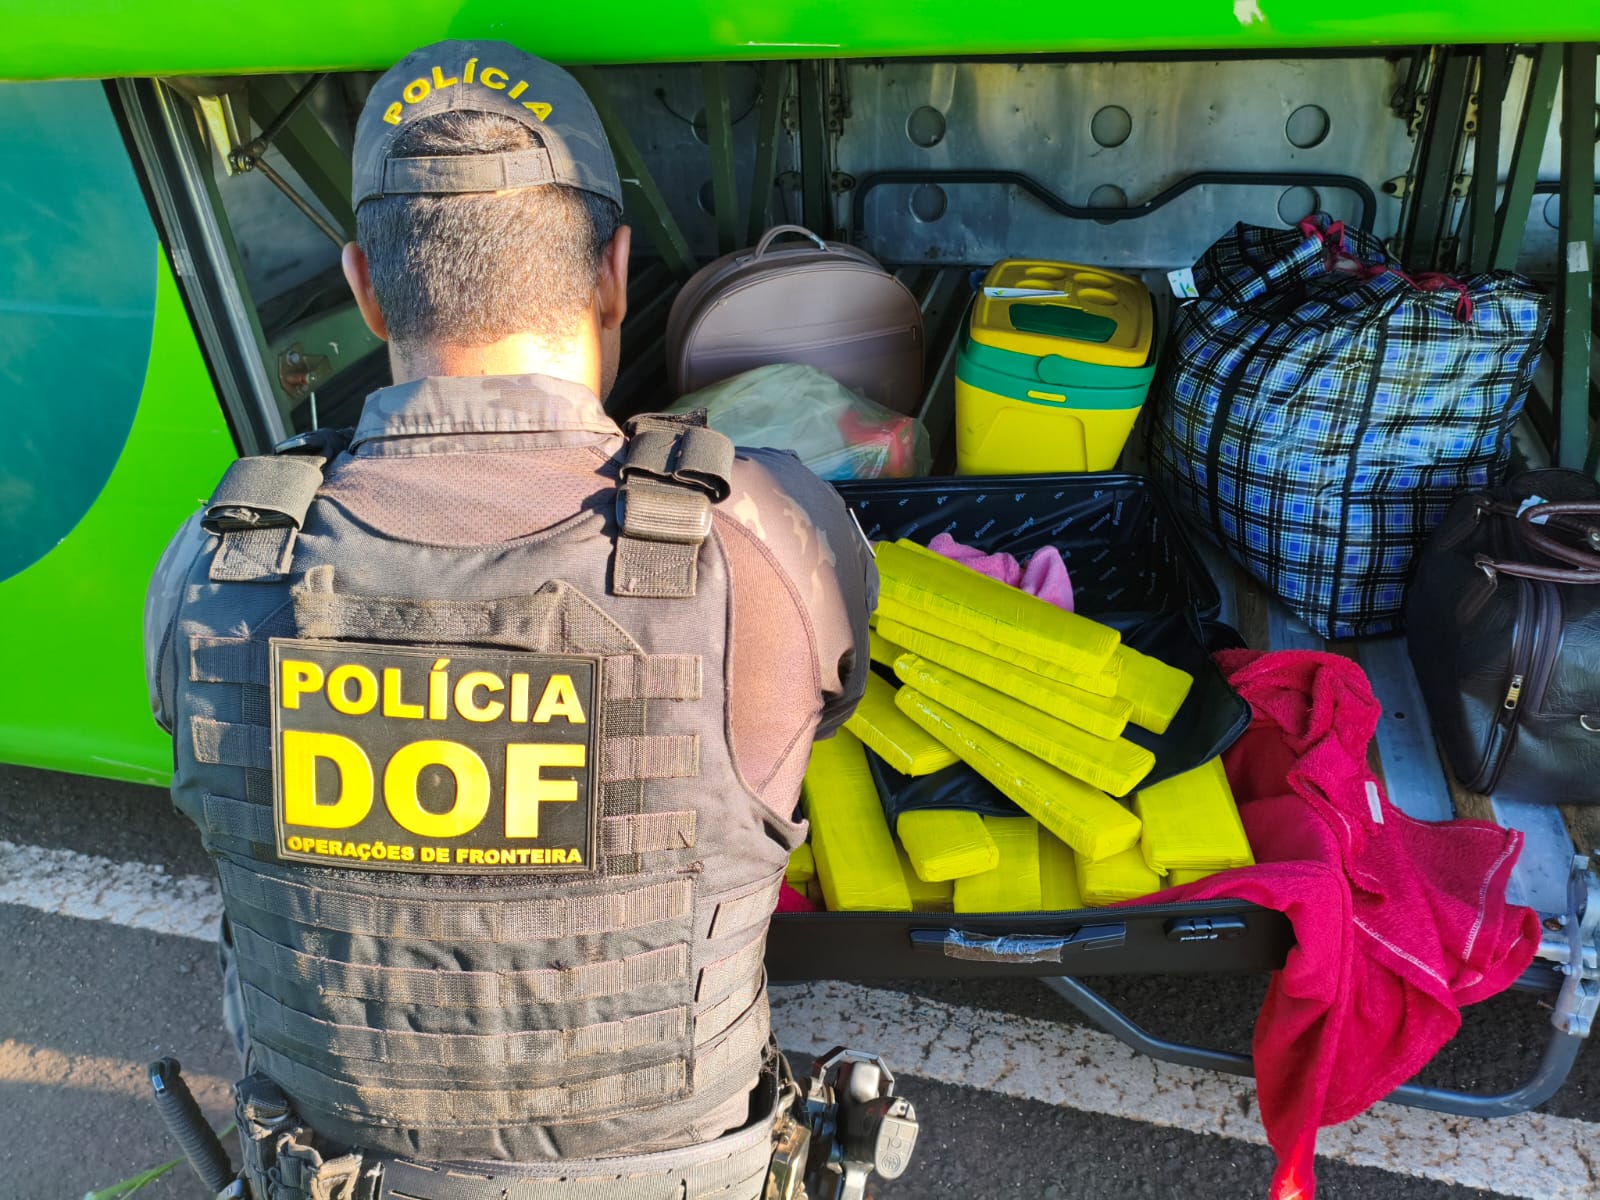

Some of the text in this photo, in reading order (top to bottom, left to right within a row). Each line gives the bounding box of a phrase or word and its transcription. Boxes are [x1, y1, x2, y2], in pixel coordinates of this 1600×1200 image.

[383, 57, 552, 126] POLÍCIA
[281, 659, 586, 723] POLÍCIA
[283, 730, 586, 838] DOF
[288, 836, 582, 864] OPERAÇÕES DE FRONTEIRA
